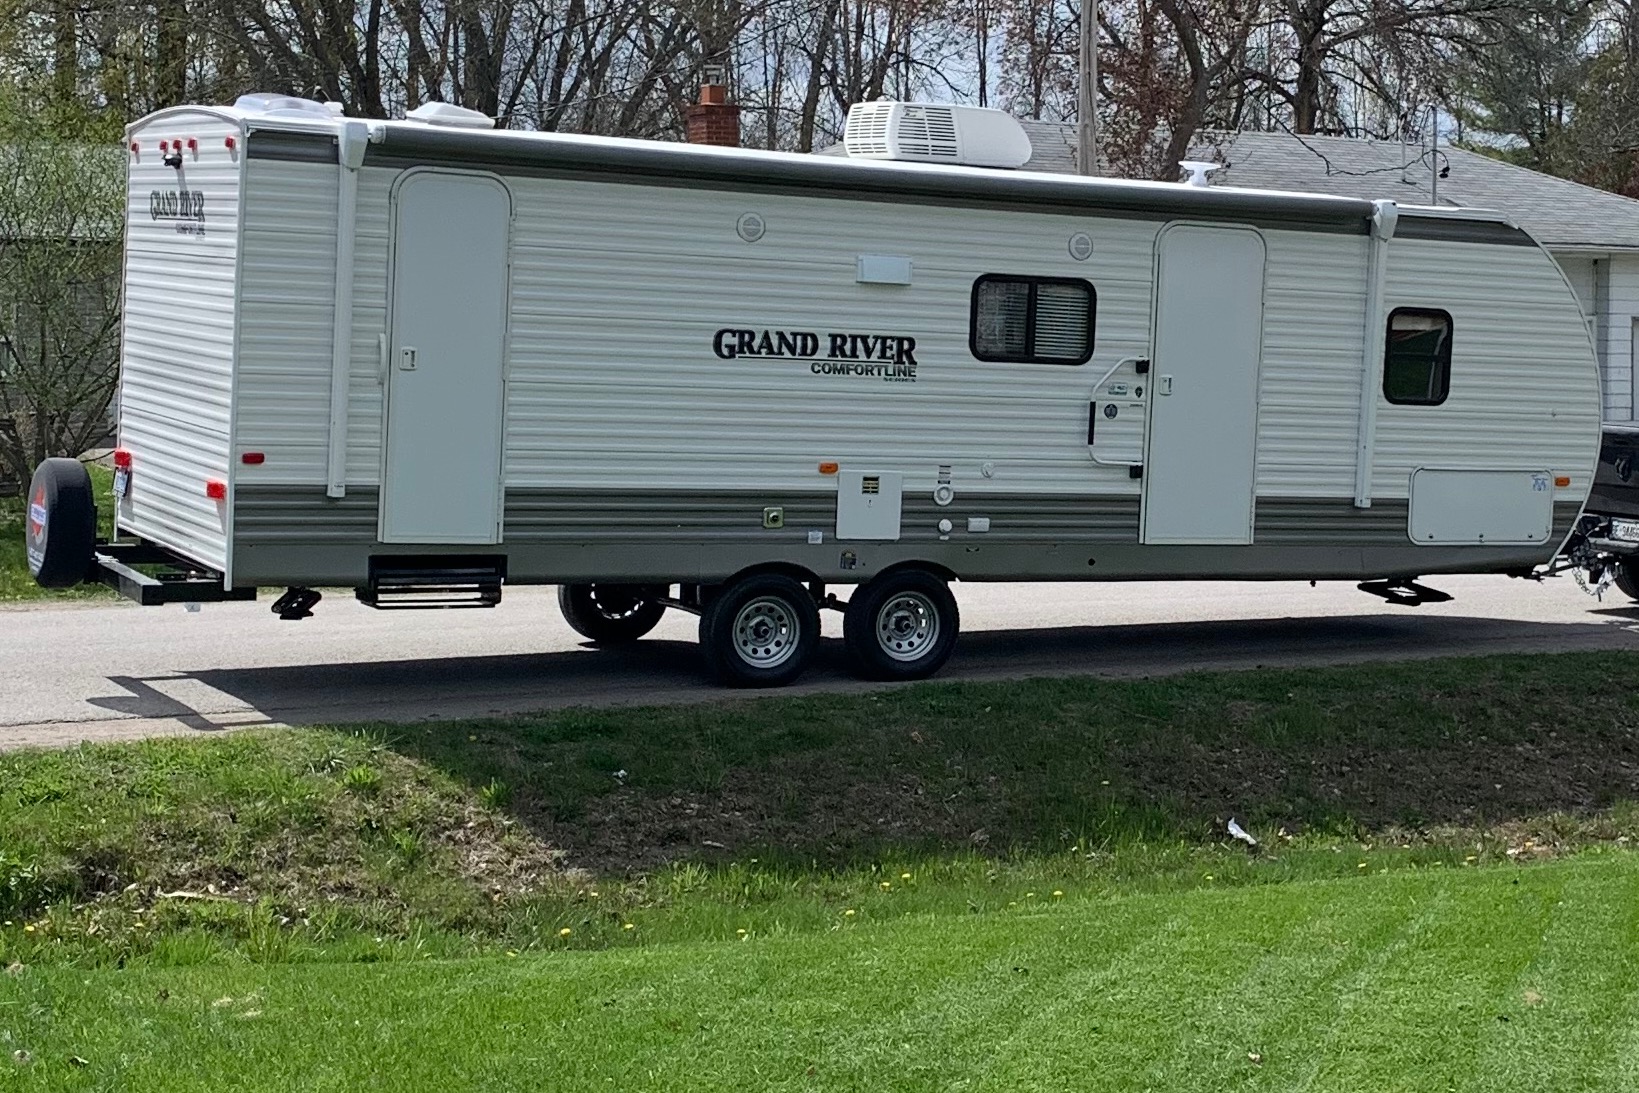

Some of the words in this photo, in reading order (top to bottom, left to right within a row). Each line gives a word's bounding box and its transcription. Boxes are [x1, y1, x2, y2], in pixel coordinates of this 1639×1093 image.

[713, 328, 819, 359] GRAND
[827, 332, 918, 366] RIVER
[810, 362, 917, 378] COMFORTLINE
